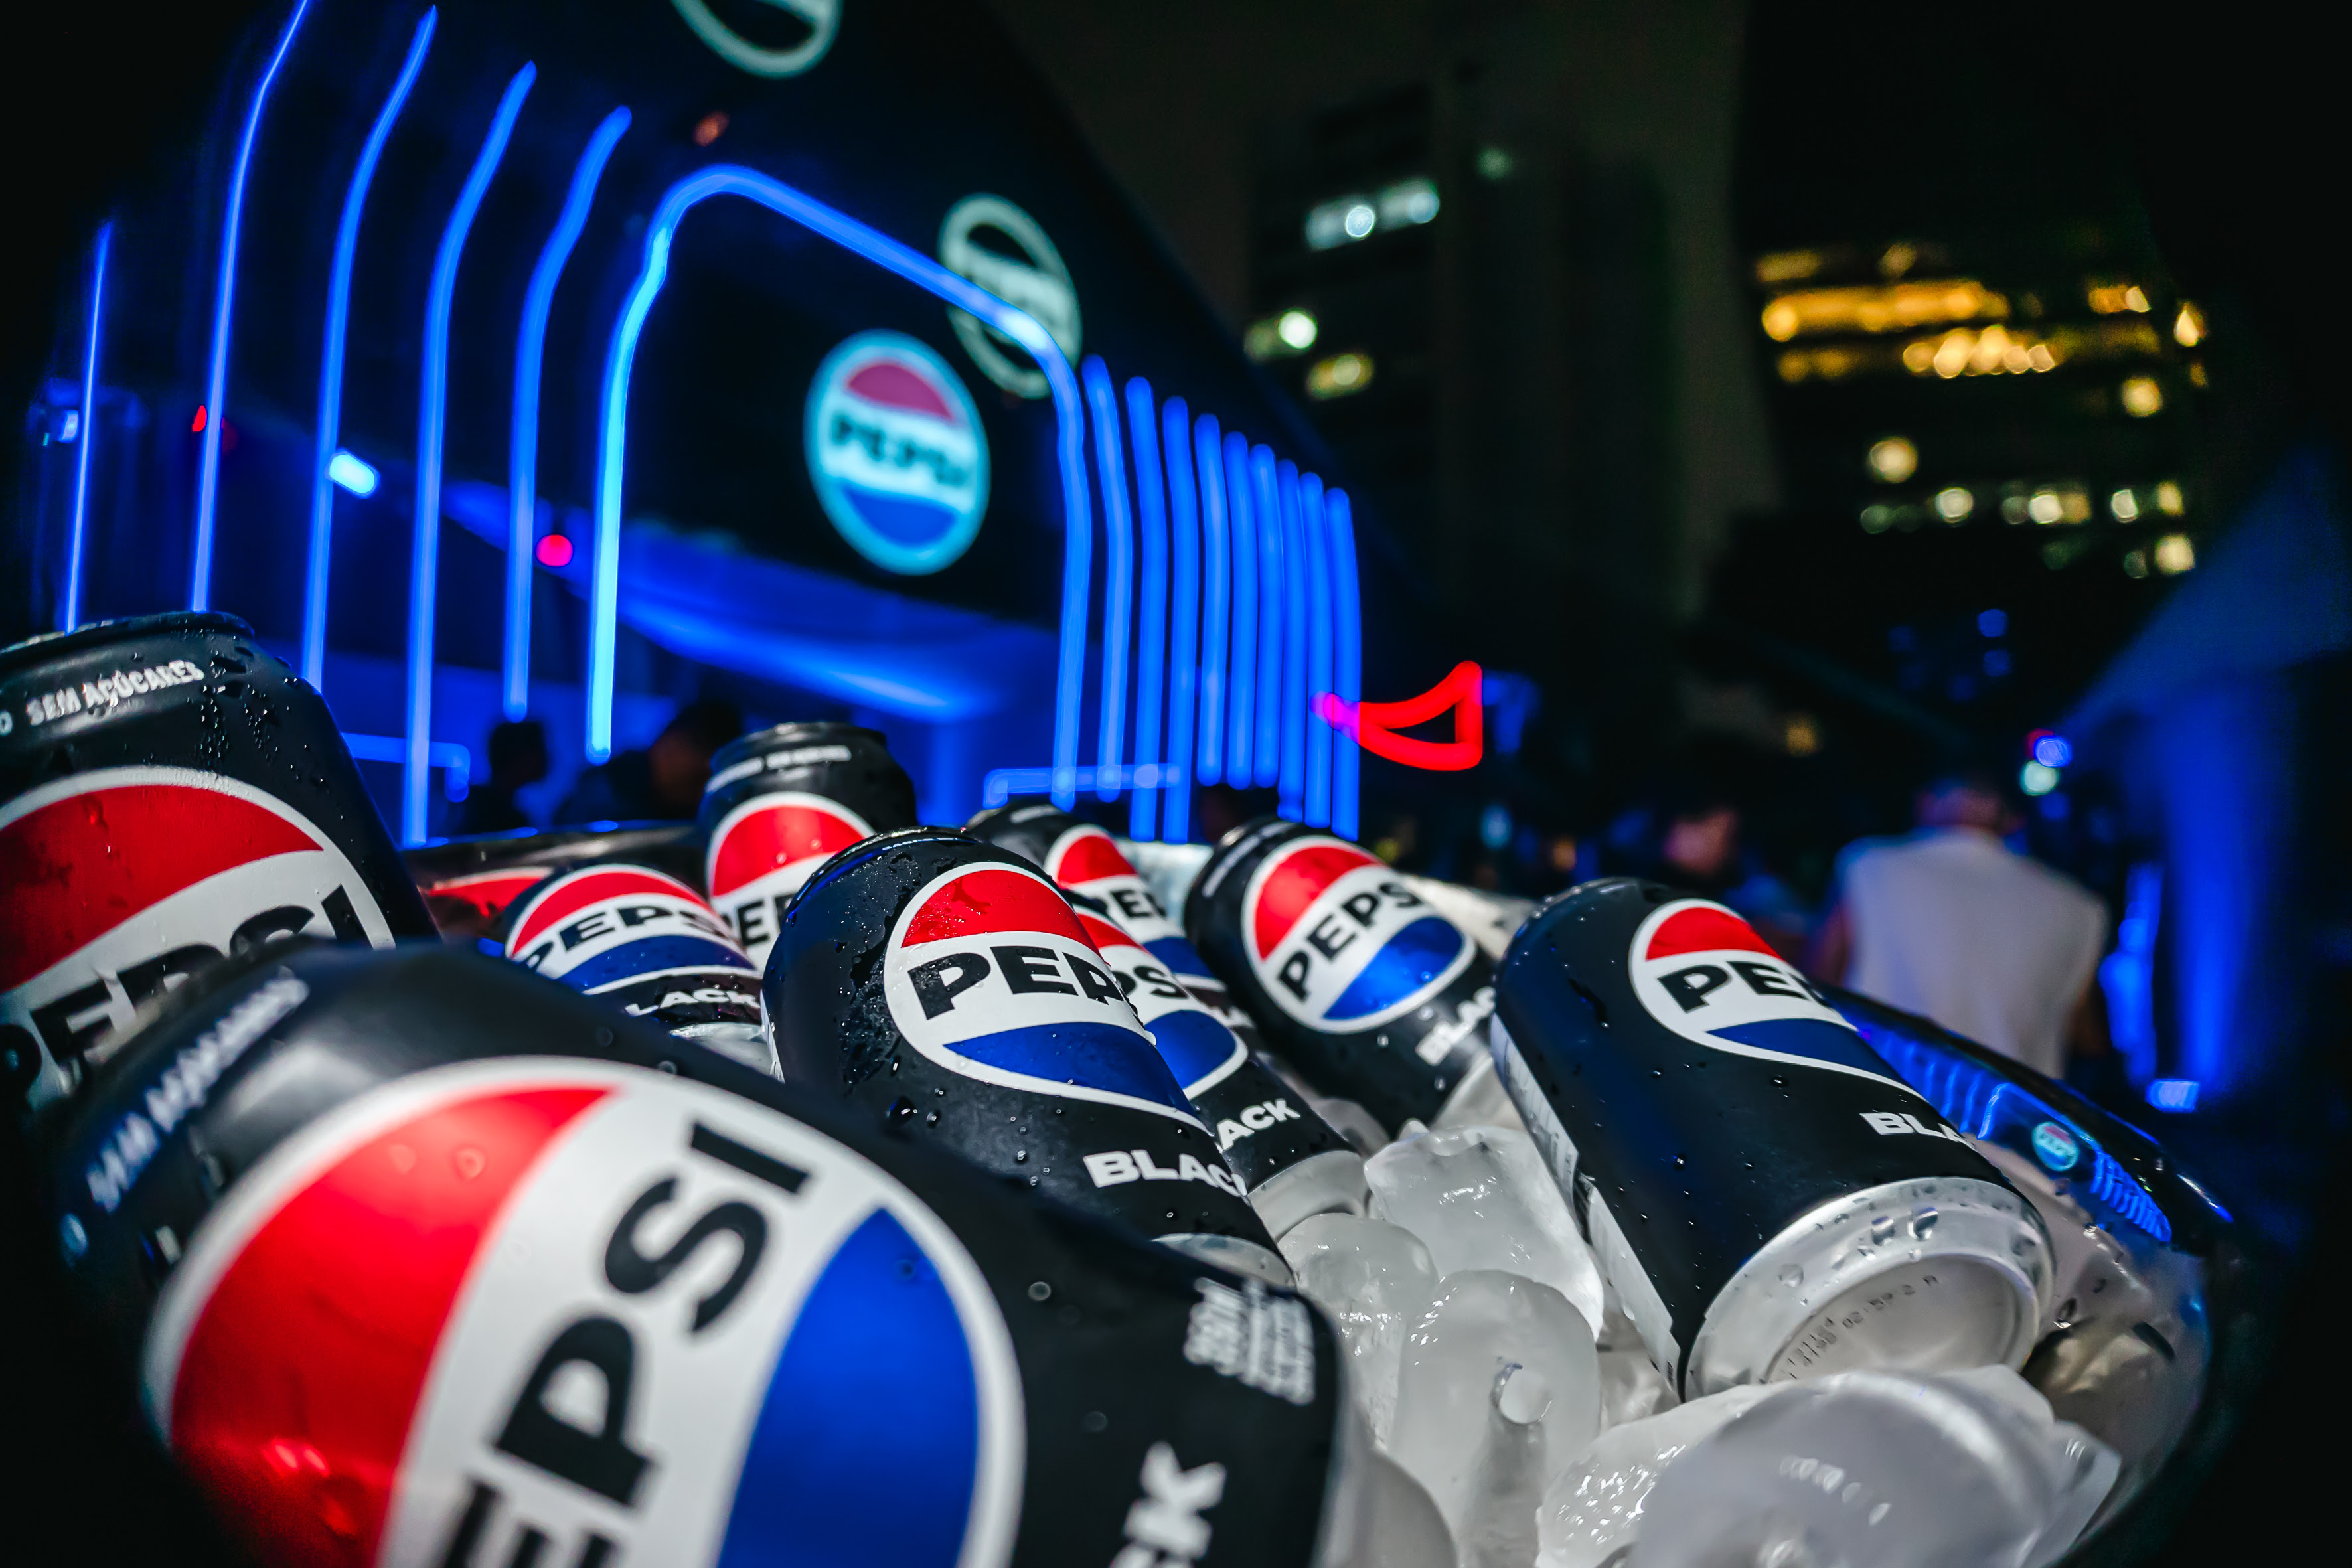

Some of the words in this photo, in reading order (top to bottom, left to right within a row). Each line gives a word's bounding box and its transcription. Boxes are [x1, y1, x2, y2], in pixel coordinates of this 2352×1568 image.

[1277, 881, 1423, 1002] PEPS
[624, 988, 761, 1018] LACK
[907, 945, 1125, 1020] PEP
[1215, 1098, 1301, 1154] ACK
[1083, 1149, 1247, 1198] BLAC
